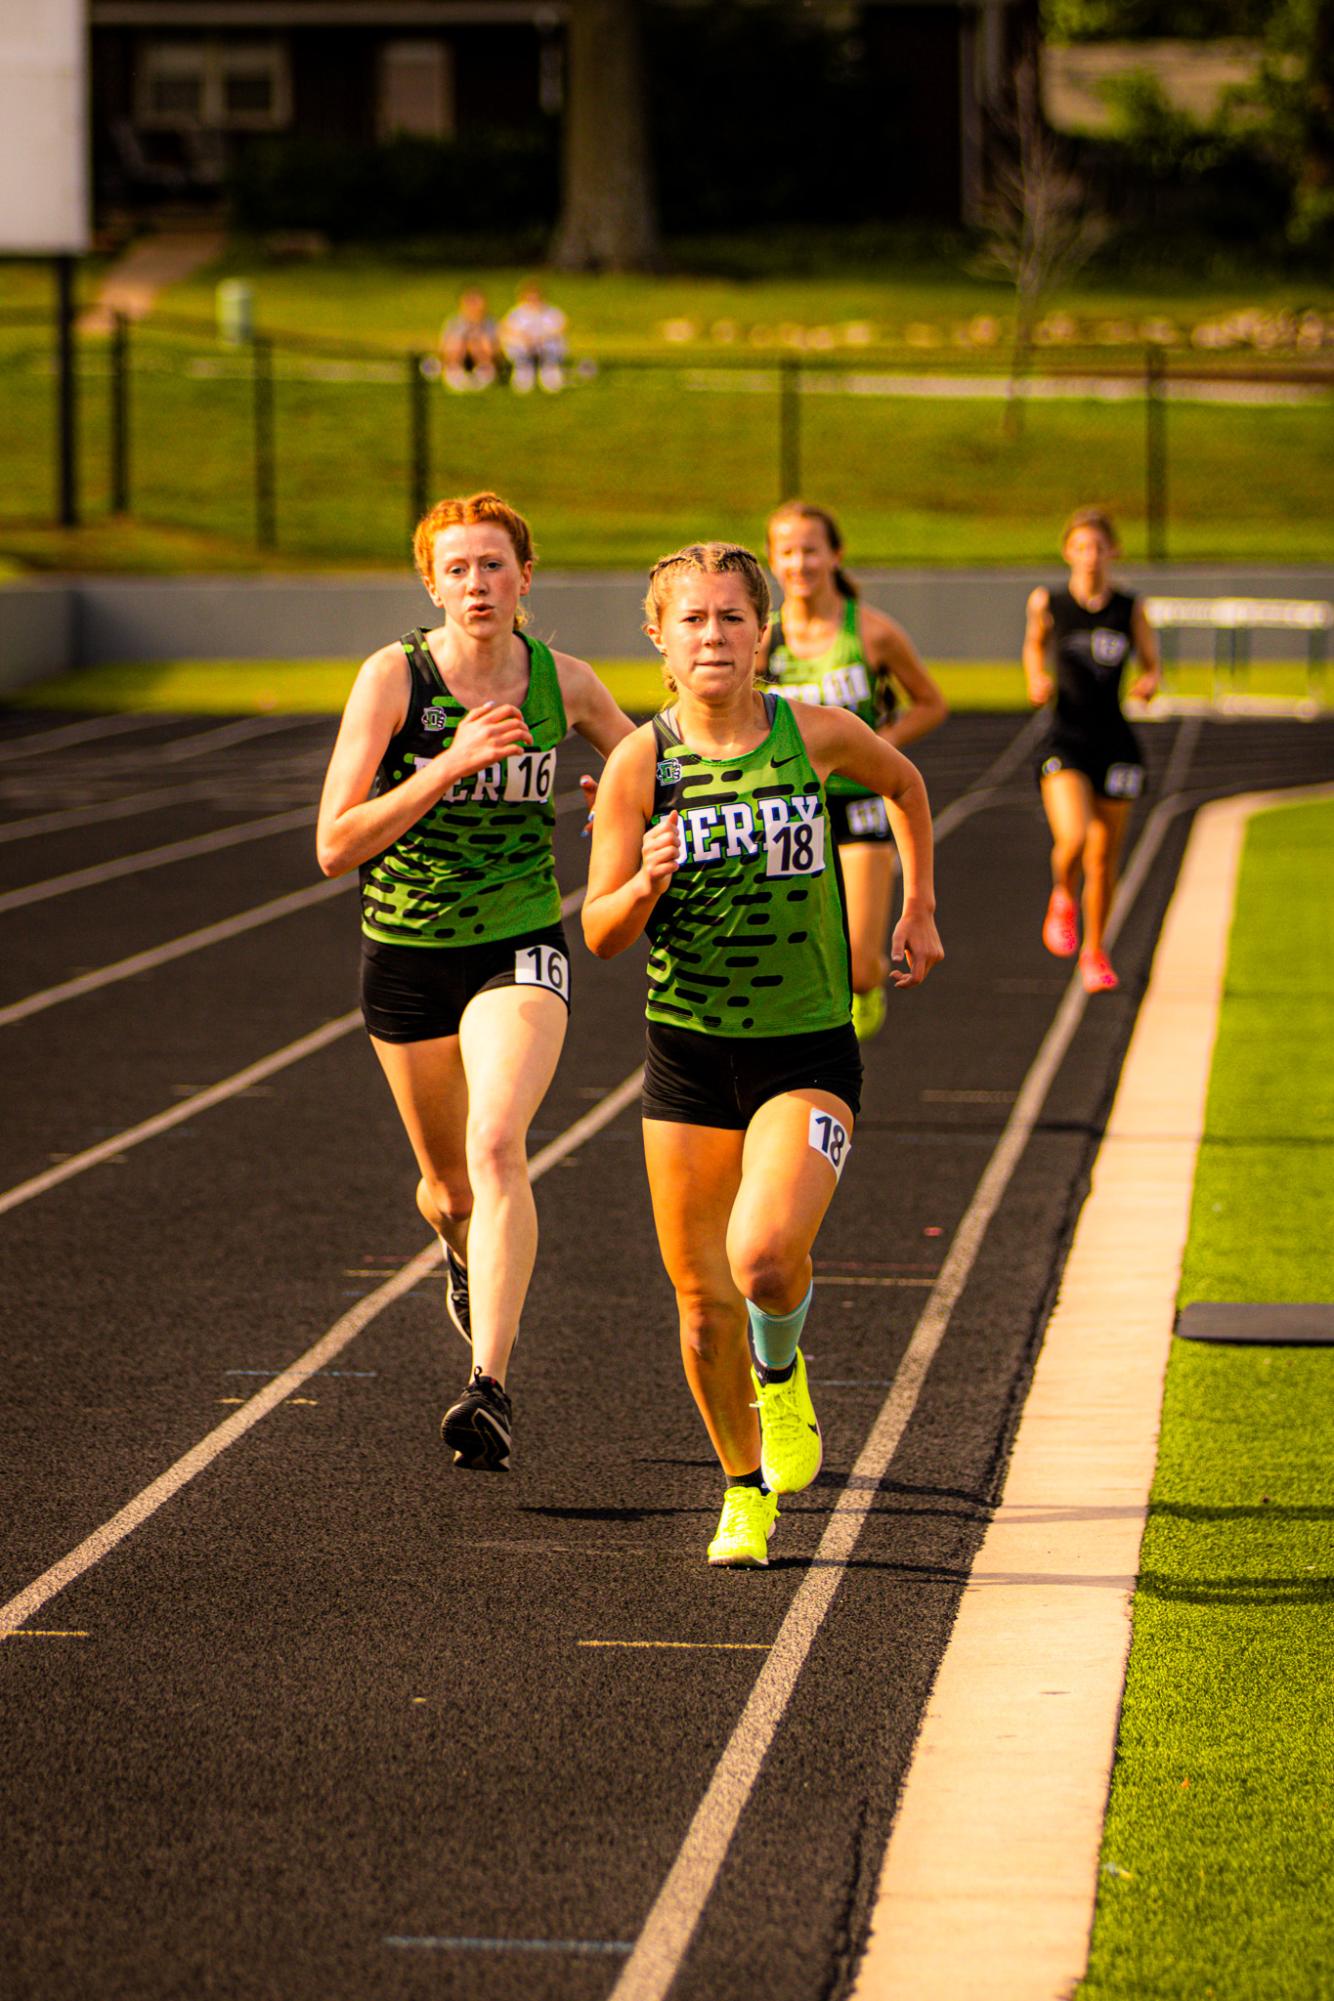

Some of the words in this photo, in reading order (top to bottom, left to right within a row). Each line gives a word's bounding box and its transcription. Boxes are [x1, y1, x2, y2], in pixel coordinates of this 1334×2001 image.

[518, 753, 551, 798] 16
[772, 823, 814, 872] 18
[527, 946, 563, 990] 16
[815, 1115, 845, 1168] 18
